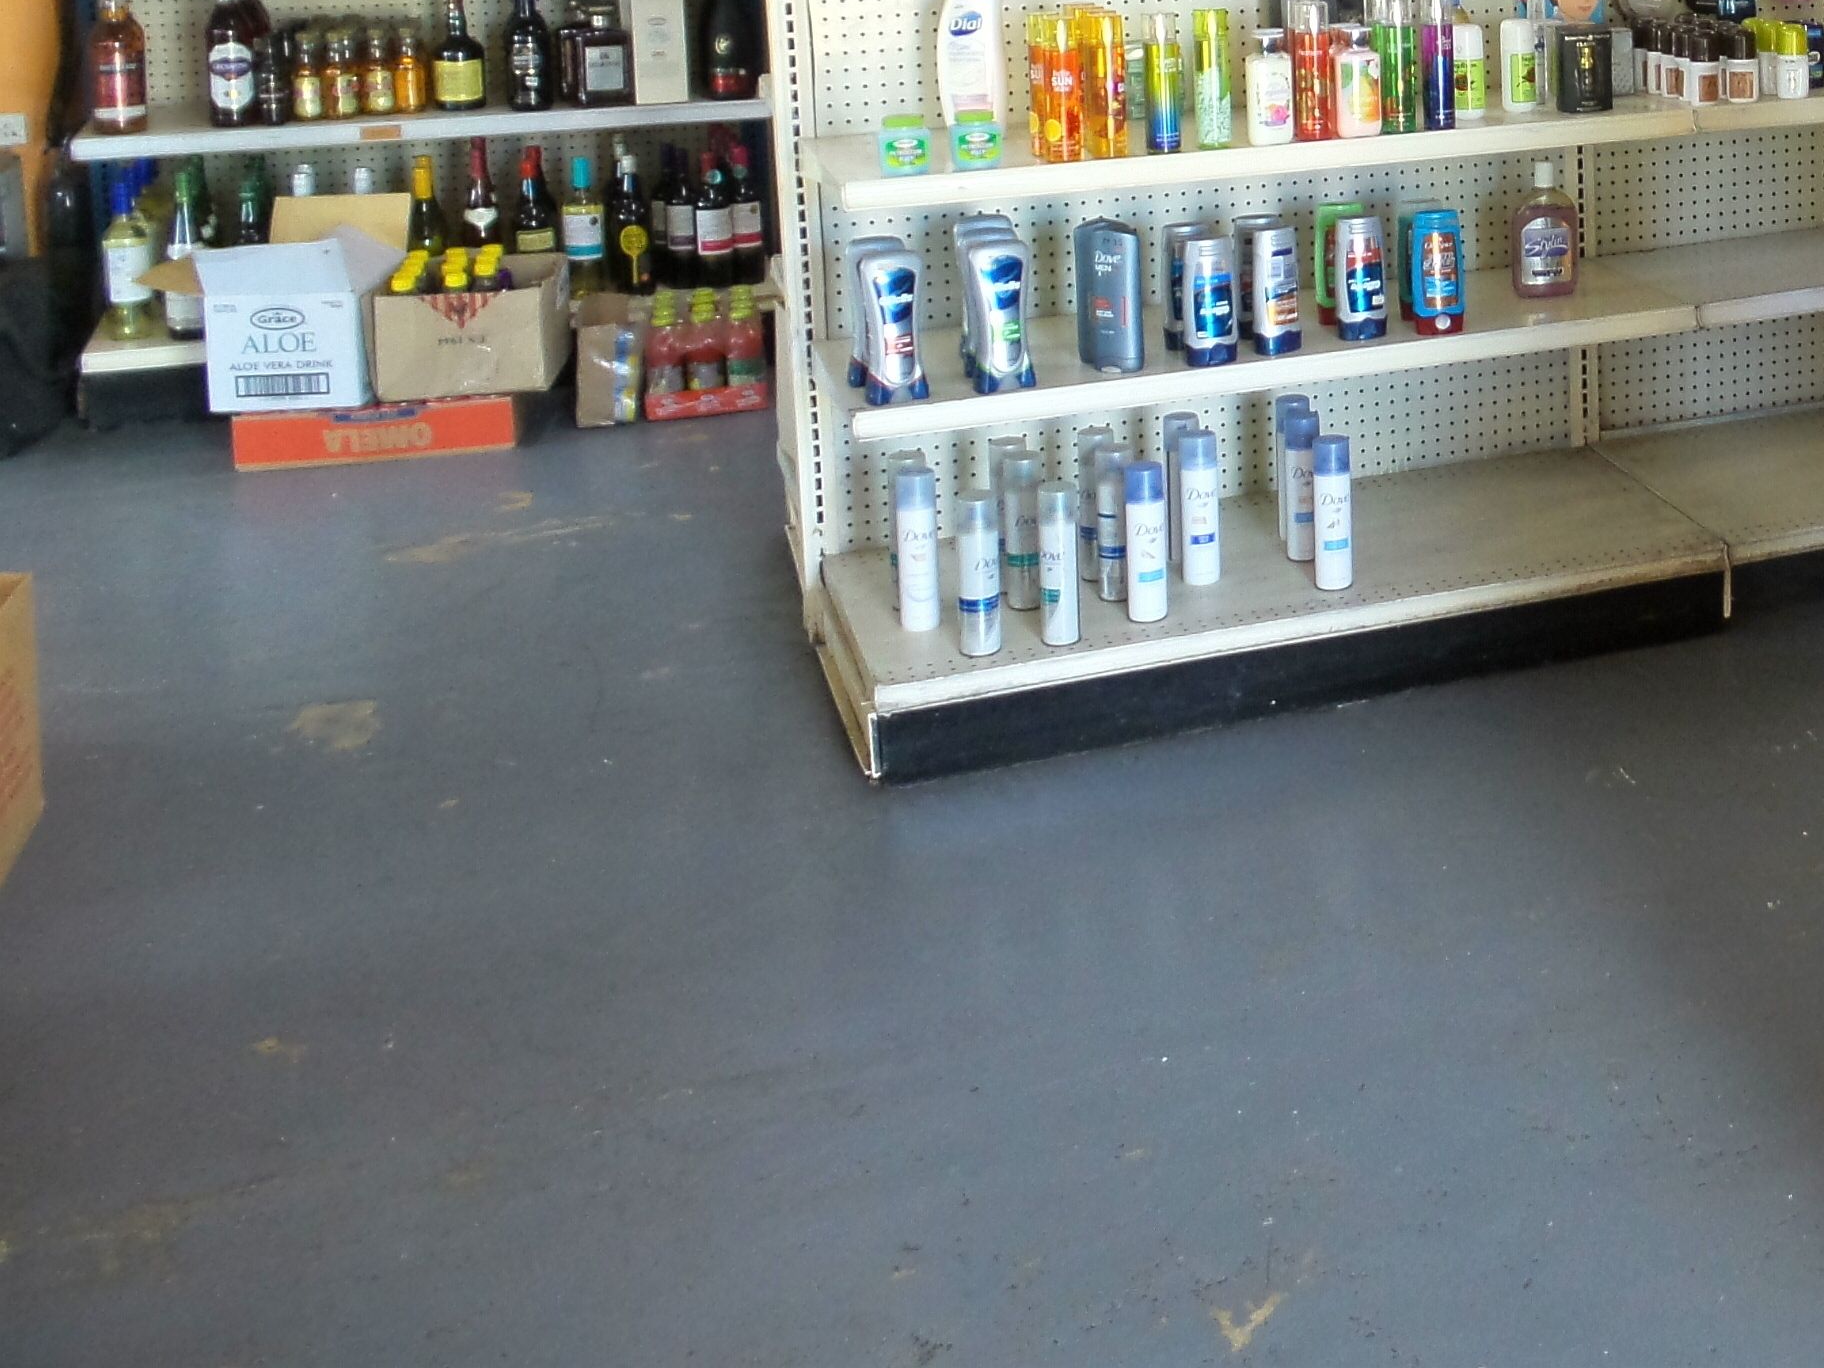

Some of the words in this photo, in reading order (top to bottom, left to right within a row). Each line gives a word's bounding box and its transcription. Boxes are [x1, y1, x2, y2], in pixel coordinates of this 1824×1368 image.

[950, 16, 983, 30] Dial
[1030, 69, 1043, 79] SU
[1051, 75, 1073, 87] SUN
[1094, 250, 1121, 265] Dove
[257, 314, 297, 324] Grace
[242, 332, 317, 353] ALOE
[229, 360, 259, 371] ALOE
[264, 360, 292, 370] VERA
[296, 359, 333, 369] DRINK
[1291, 466, 1315, 480] Dov
[1014, 515, 1037, 528] Dov
[975, 557, 1000, 572] Dov
